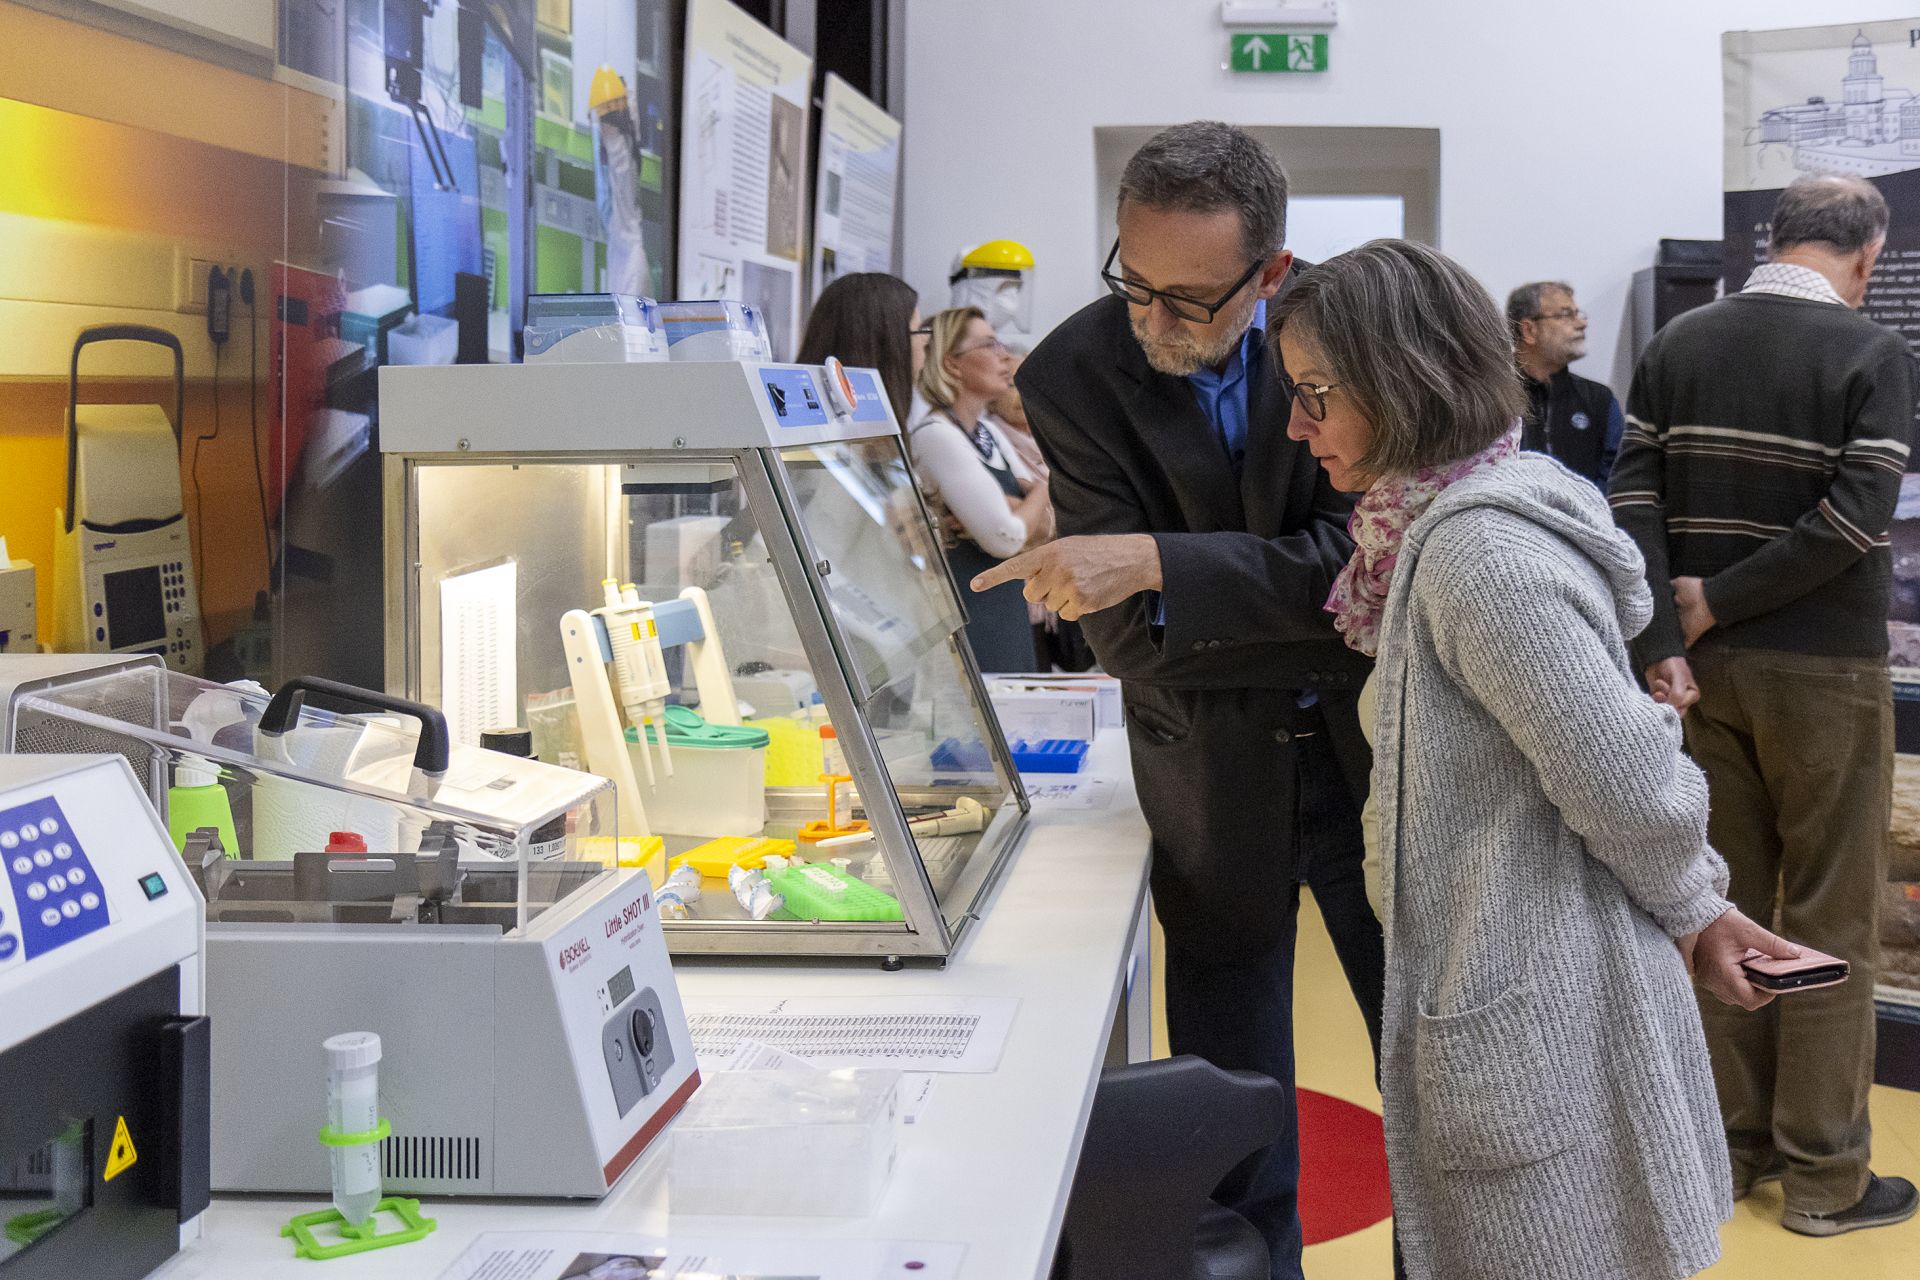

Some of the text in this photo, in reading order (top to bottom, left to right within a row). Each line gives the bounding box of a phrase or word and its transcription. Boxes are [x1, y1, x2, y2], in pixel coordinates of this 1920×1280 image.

[604, 914, 623, 938] Little
[622, 898, 641, 925] SHOT
[564, 936, 591, 964] BOEKEL
